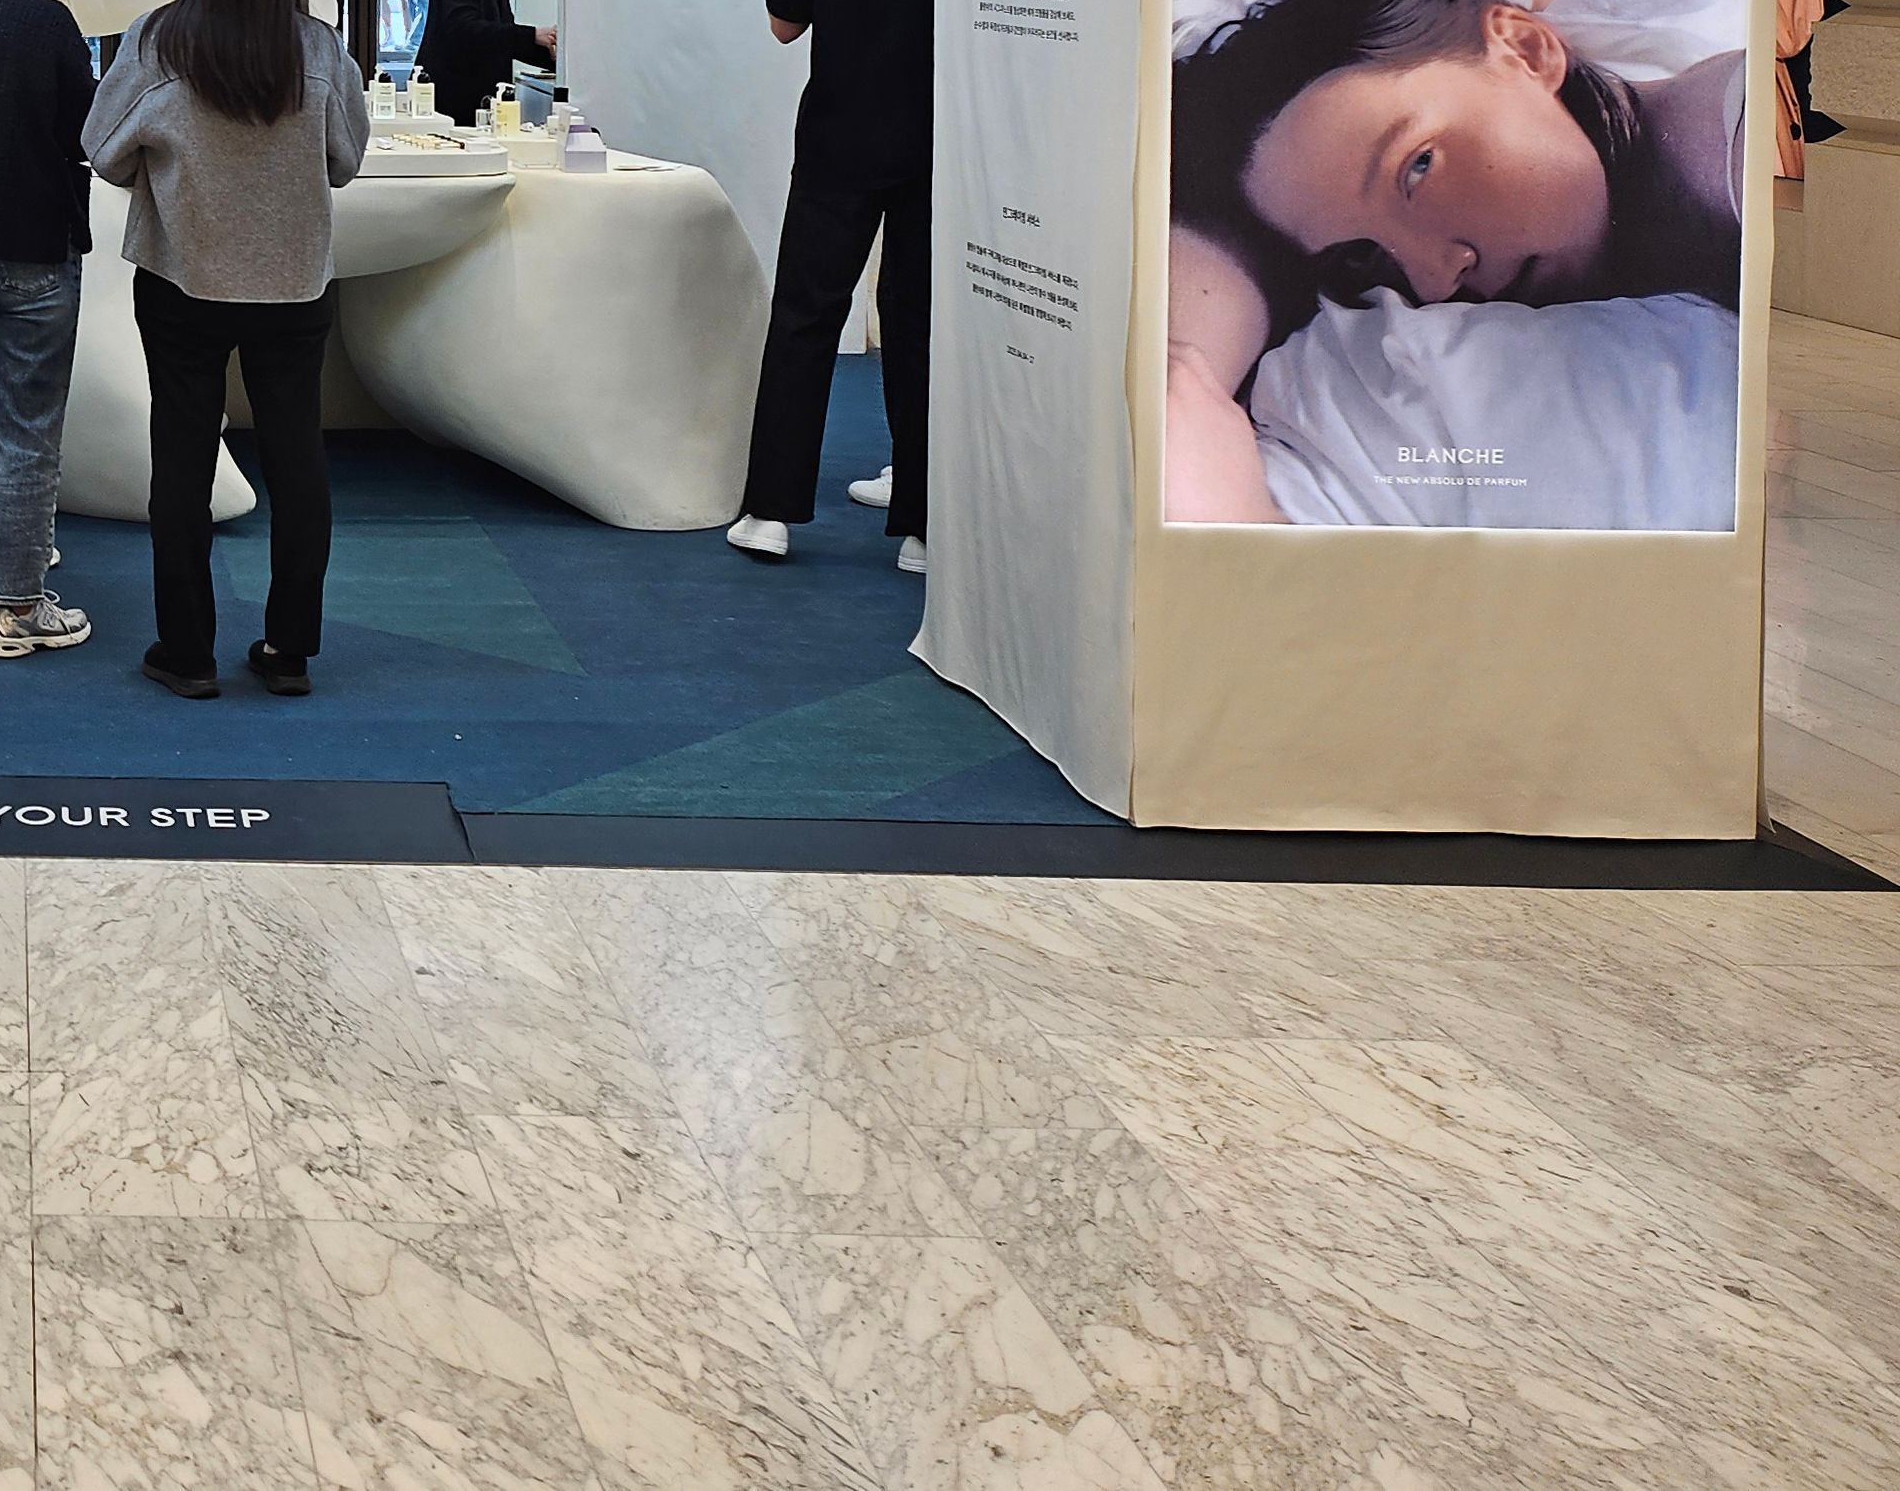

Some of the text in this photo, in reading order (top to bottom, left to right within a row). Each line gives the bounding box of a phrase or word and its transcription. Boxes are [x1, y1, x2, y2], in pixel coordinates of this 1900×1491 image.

[1398, 446, 1505, 465] BLANCHE
[1374, 475, 1528, 487] THE NEW ABSOLU DE PARFUM
[150, 807, 271, 828] STEP
